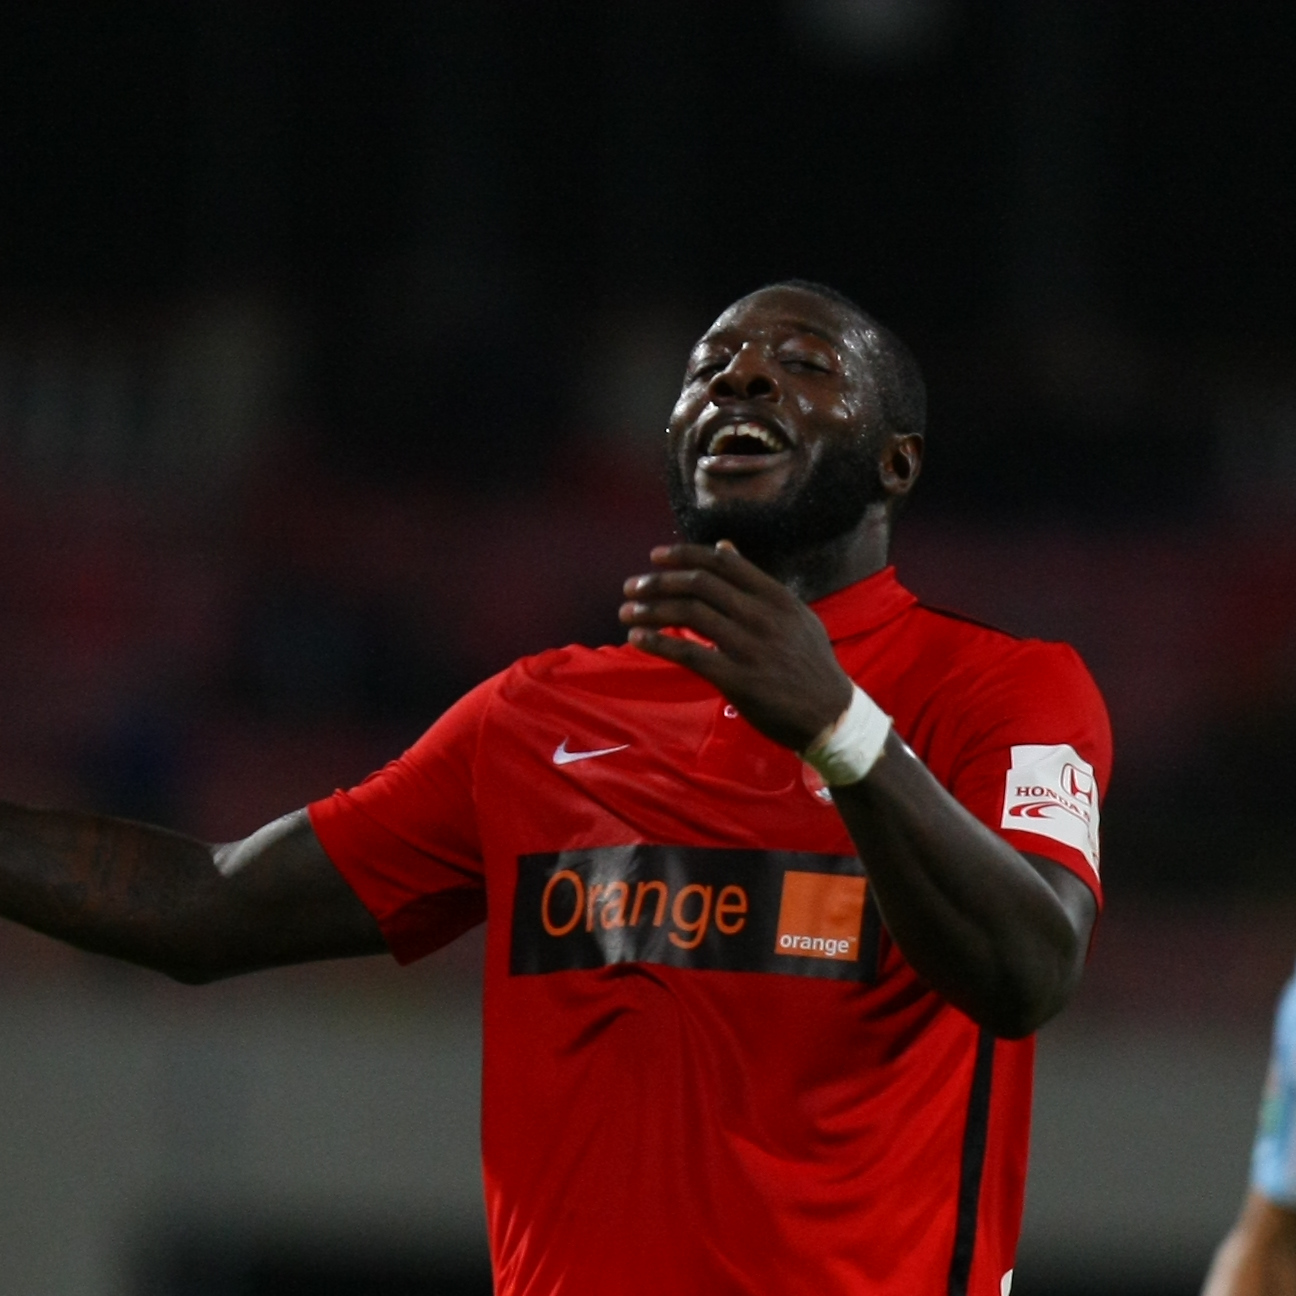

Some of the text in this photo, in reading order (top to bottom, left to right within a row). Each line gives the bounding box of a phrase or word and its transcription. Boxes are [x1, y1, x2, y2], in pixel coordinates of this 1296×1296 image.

[1015, 786, 1082, 816] HONDA
[541, 869, 749, 949] Orange
[780, 934, 850, 957] orange
